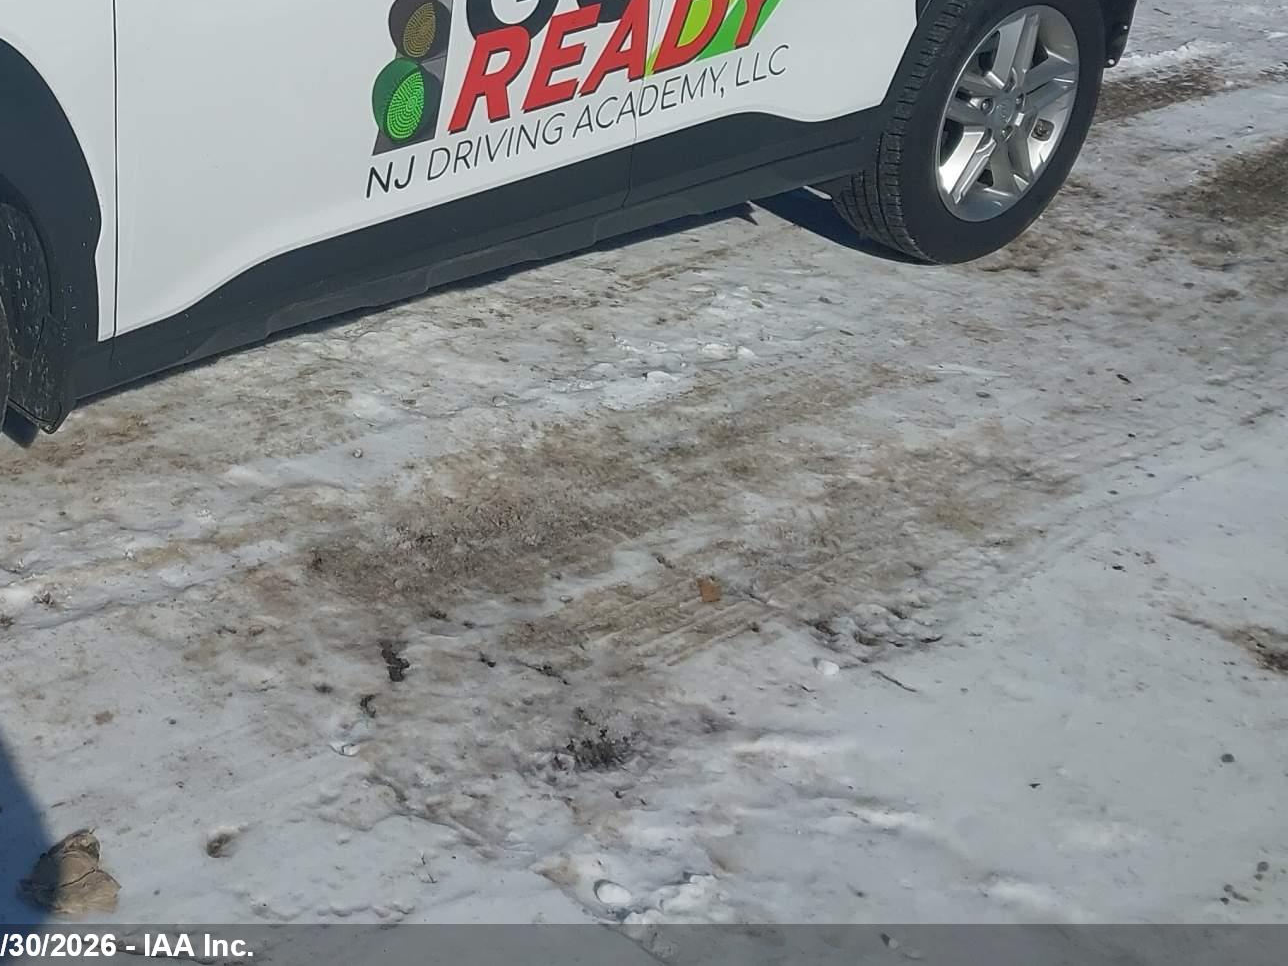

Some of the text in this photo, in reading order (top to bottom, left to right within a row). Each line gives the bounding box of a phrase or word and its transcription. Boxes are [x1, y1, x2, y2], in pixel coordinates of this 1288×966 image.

[365, 44, 790, 198] NJ DRIVING ACADEMY, LLC
